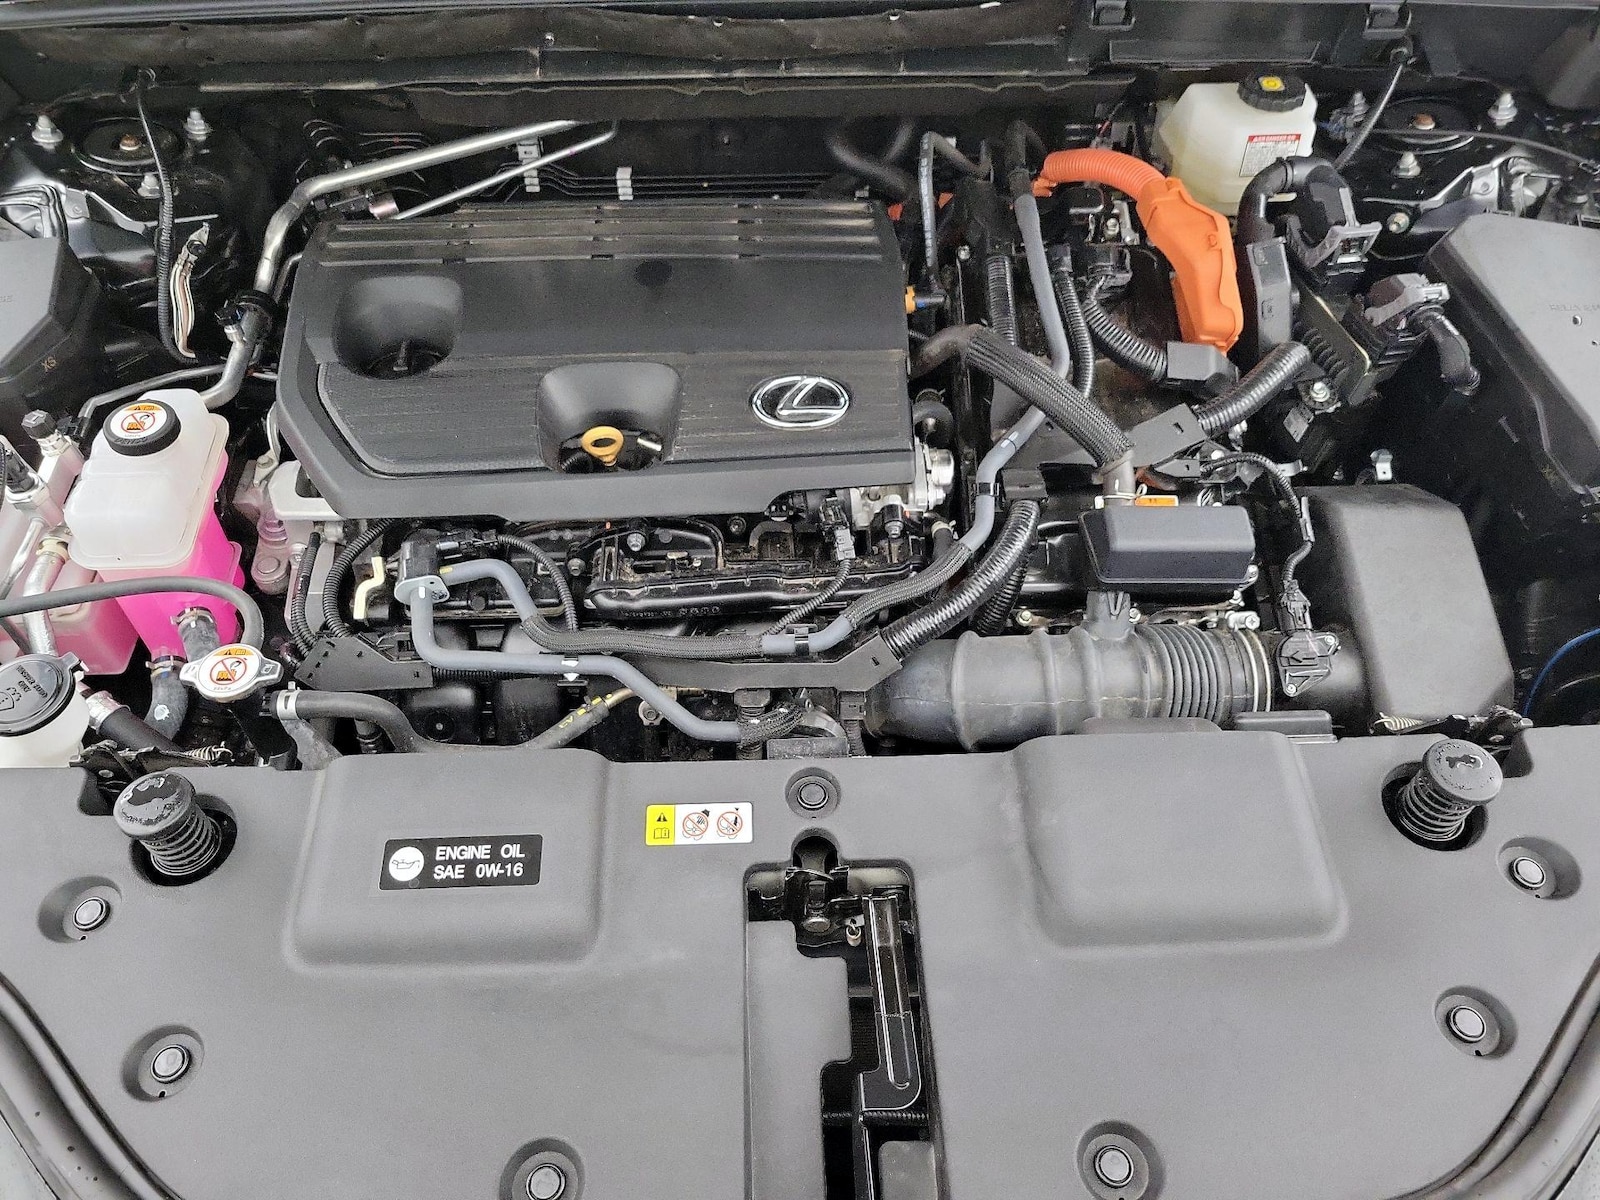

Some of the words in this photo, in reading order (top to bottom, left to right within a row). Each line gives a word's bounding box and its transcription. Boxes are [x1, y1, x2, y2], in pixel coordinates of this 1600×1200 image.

[435, 845, 491, 860] ENGINE
[501, 843, 525, 859] OIL
[433, 864, 465, 880] SAE
[475, 862, 524, 878] 0W-16
